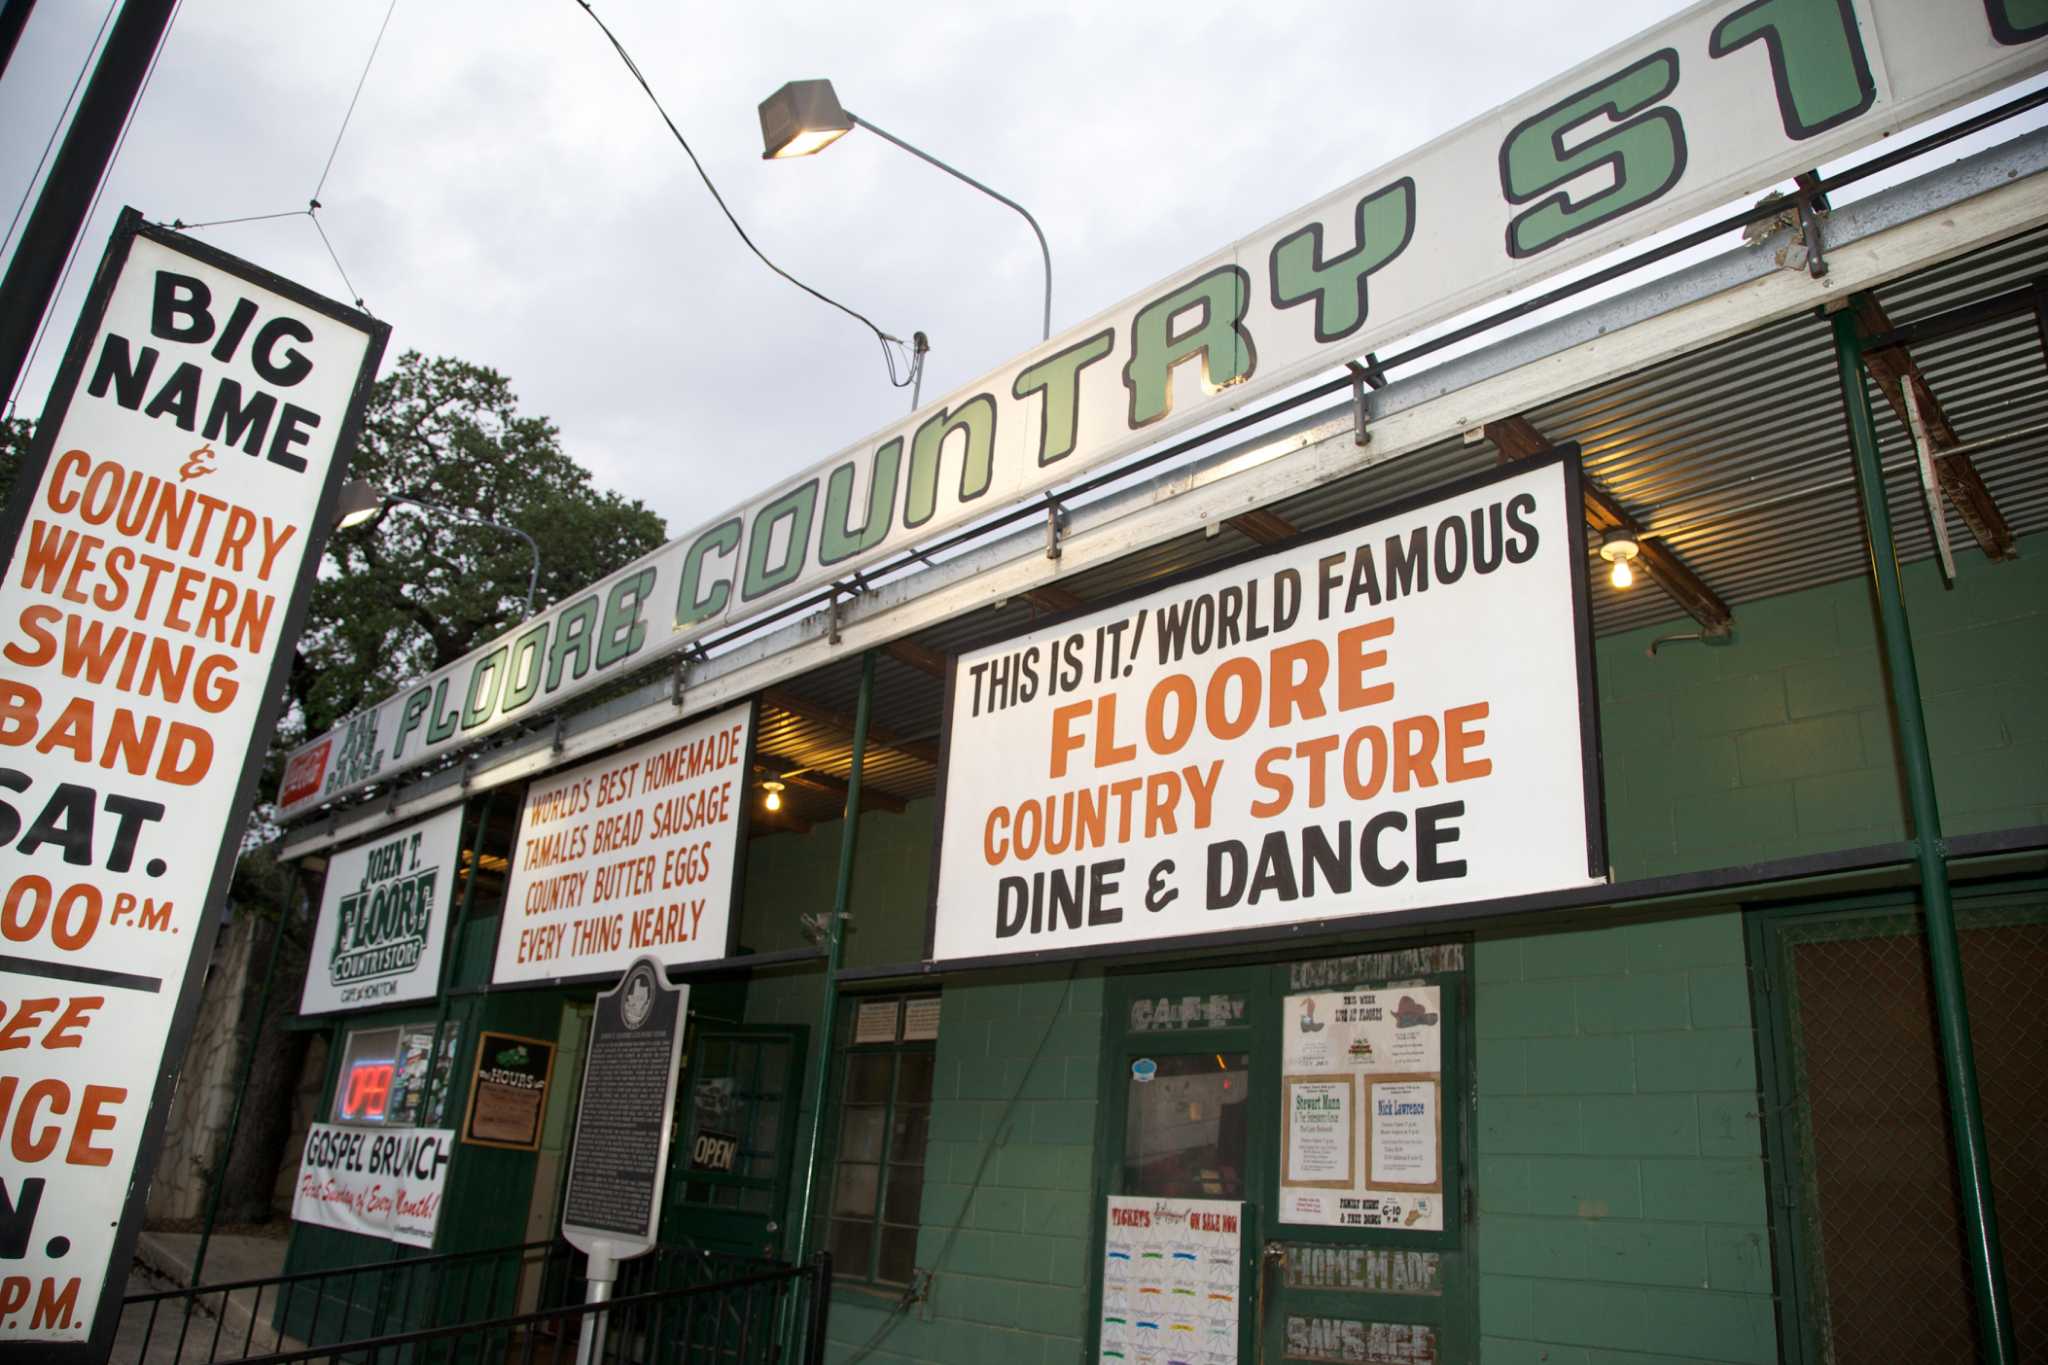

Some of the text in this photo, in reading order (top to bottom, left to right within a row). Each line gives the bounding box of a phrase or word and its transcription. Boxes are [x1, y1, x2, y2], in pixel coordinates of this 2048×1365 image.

[1499, 0, 2048, 258] ST
[151, 270, 313, 387] BIG
[88, 332, 321, 474] NAME
[180, 444, 218, 482] &
[47, 449, 297, 582] COUNTRY
[20, 520, 275, 654] WESTERN
[969, 493, 1540, 717] THIS IS IT! WORLD FAMOUS
[3, 605, 239, 714] SWING
[1048, 616, 1395, 778] FLOORE
[0, 680, 214, 786] BAND
[530, 724, 742, 827] WORLD'S BEST HOMEMADE
[523, 782, 732, 872] TAMALES BREAD SAUSAGE
[983, 701, 1493, 865] COUNTRY STORE
[360, 832, 423, 890] JOHN T.
[525, 841, 711, 916] COUNTRY BUTTER EGGS
[995, 800, 1467, 938] DINE & DANCE
[110, 893, 179, 934] P.M.
[330, 871, 438, 968] FLOORE
[517, 898, 706, 964] EVERY THING NEARLY
[0, 996, 104, 1050] EE
[490, 1067, 534, 1088] HOURS
[1378, 1100, 1424, 1116] Nick Lawrence
[307, 1129, 449, 1181] GOSPEL BRUNCH
[694, 1136, 736, 1168] OPEN
[1112, 1207, 1151, 1228] TICKETS
[1202, 1212, 1220, 1232] SALE
